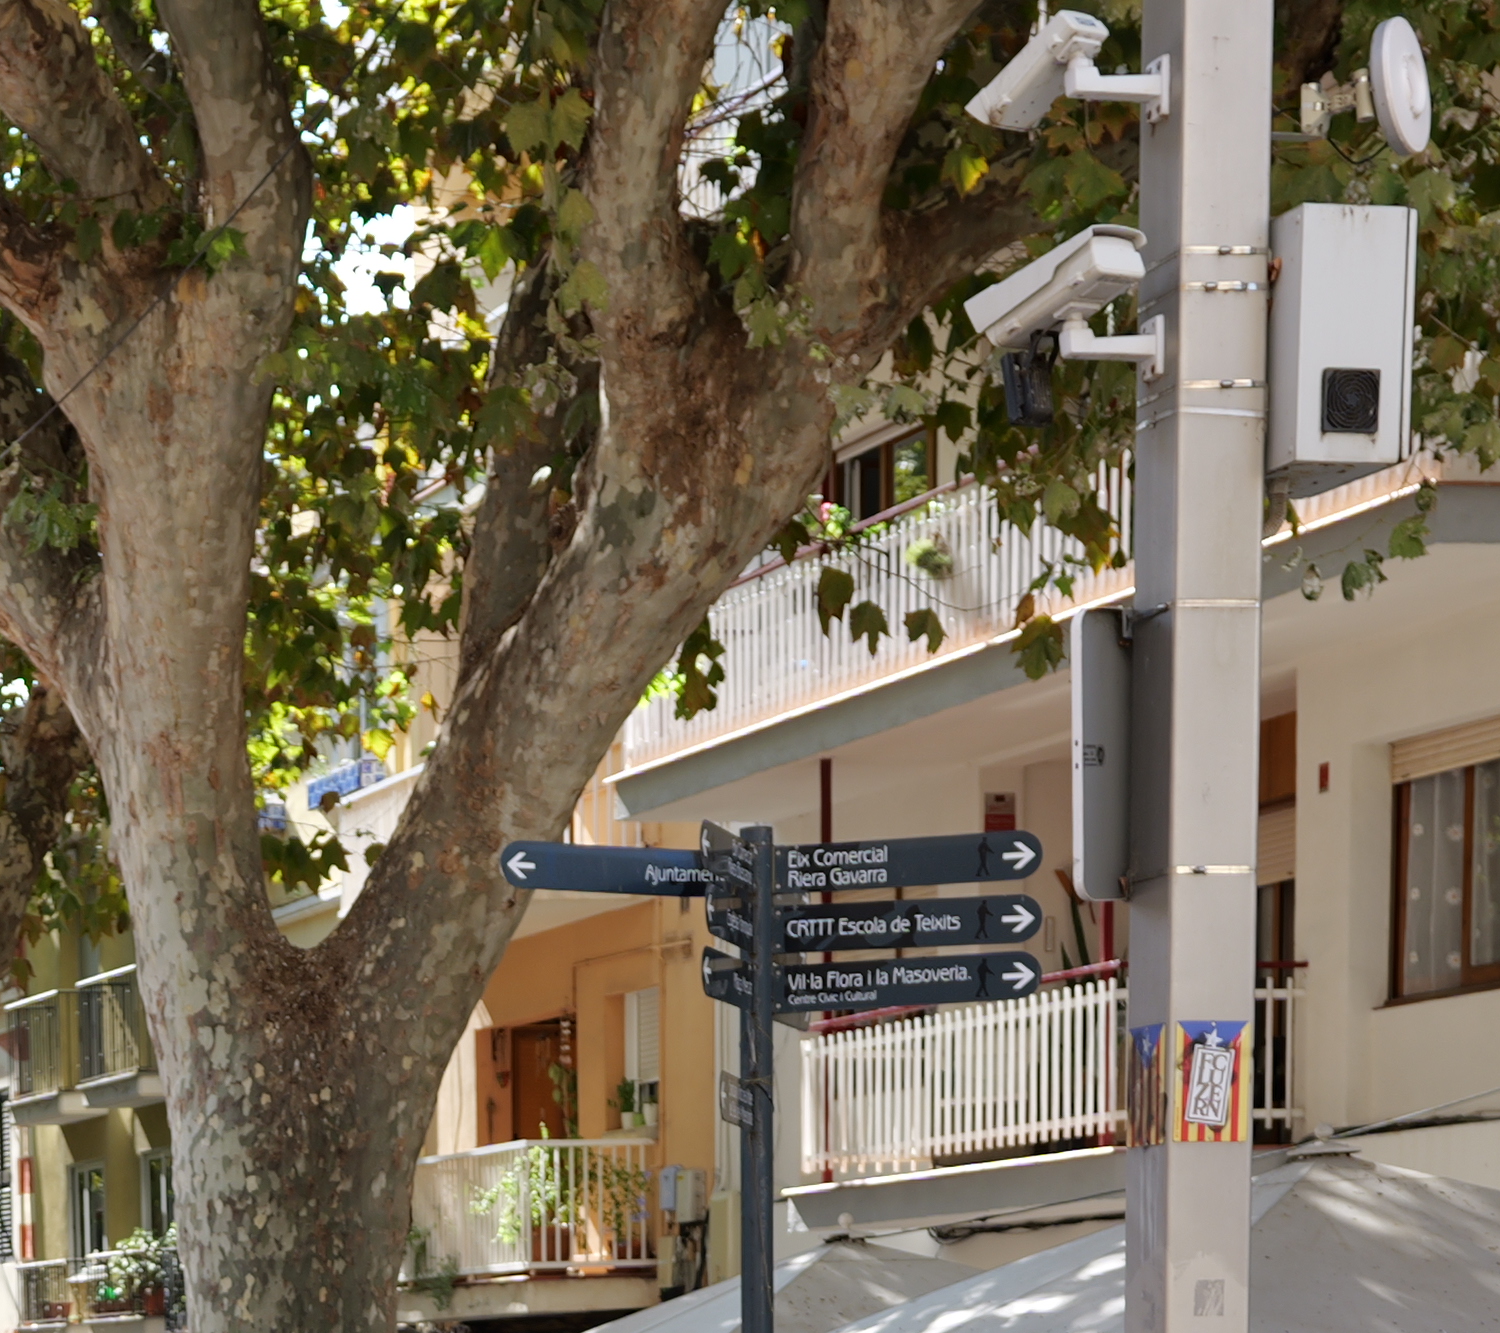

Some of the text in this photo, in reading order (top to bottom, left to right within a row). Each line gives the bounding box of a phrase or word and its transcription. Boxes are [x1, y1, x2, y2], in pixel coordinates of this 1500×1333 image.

[788, 845, 888, 868] Eix Comercial
[645, 864, 725, 885] Ajuntamen
[788, 867, 887, 888] Riera Gavarra
[786, 911, 961, 937] CRTTT Escola de Teixits
[827, 970, 863, 989] Flora
[867, 968, 872, 987] i
[876, 967, 889, 985] la
[788, 994, 817, 1006] Centre
[845, 989, 878, 1002] Cultural
